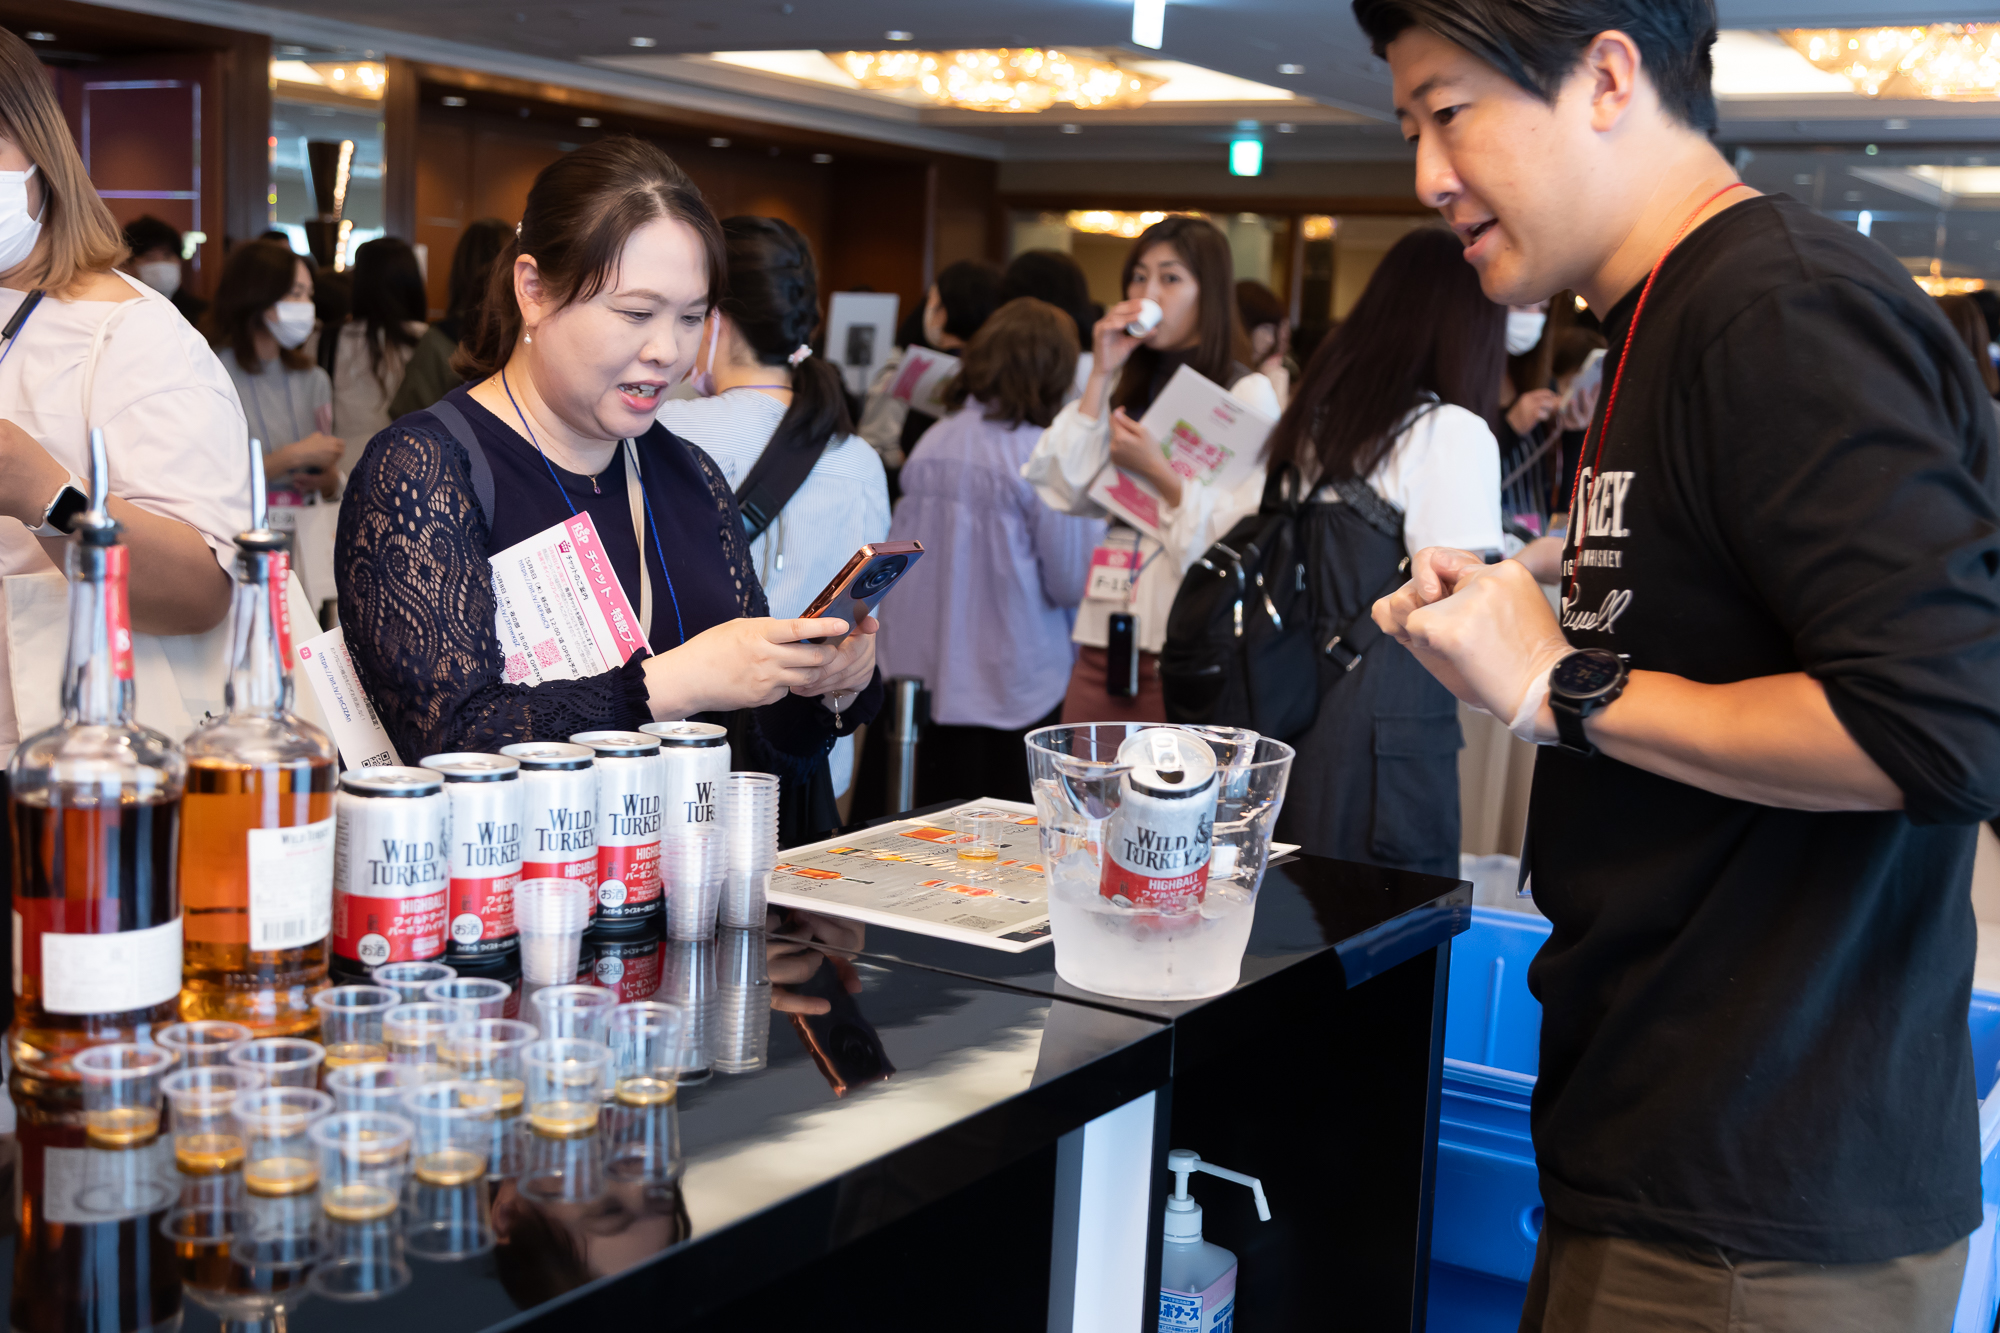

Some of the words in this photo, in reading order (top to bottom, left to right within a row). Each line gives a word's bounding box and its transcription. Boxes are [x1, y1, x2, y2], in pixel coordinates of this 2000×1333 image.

[571, 522, 590, 544] RSP
[565, 554, 589, 601] チャットのご案内
[549, 617, 560, 636] 12:00
[517, 631, 529, 650] 18:00
[302, 648, 310, 657] 21
[622, 794, 660, 816] WILD
[549, 808, 591, 831] WILD
[609, 812, 662, 836] TURKEY
[477, 822, 519, 845] WILD
[535, 827, 595, 852] TURKEY
[1137, 826, 1188, 851] WILD
[382, 839, 434, 864] WILD
[462, 841, 521, 866] TURKEY
[1124, 838, 1193, 870] TURKEY
[368, 859, 440, 886] TURKEY
[1149, 873, 1199, 891] HIGHBALL
[400, 894, 445, 914] HIGHBALL
[601, 888, 624, 900] お酒
[455, 922, 480, 936] お酒
[361, 940, 386, 957] お酒
